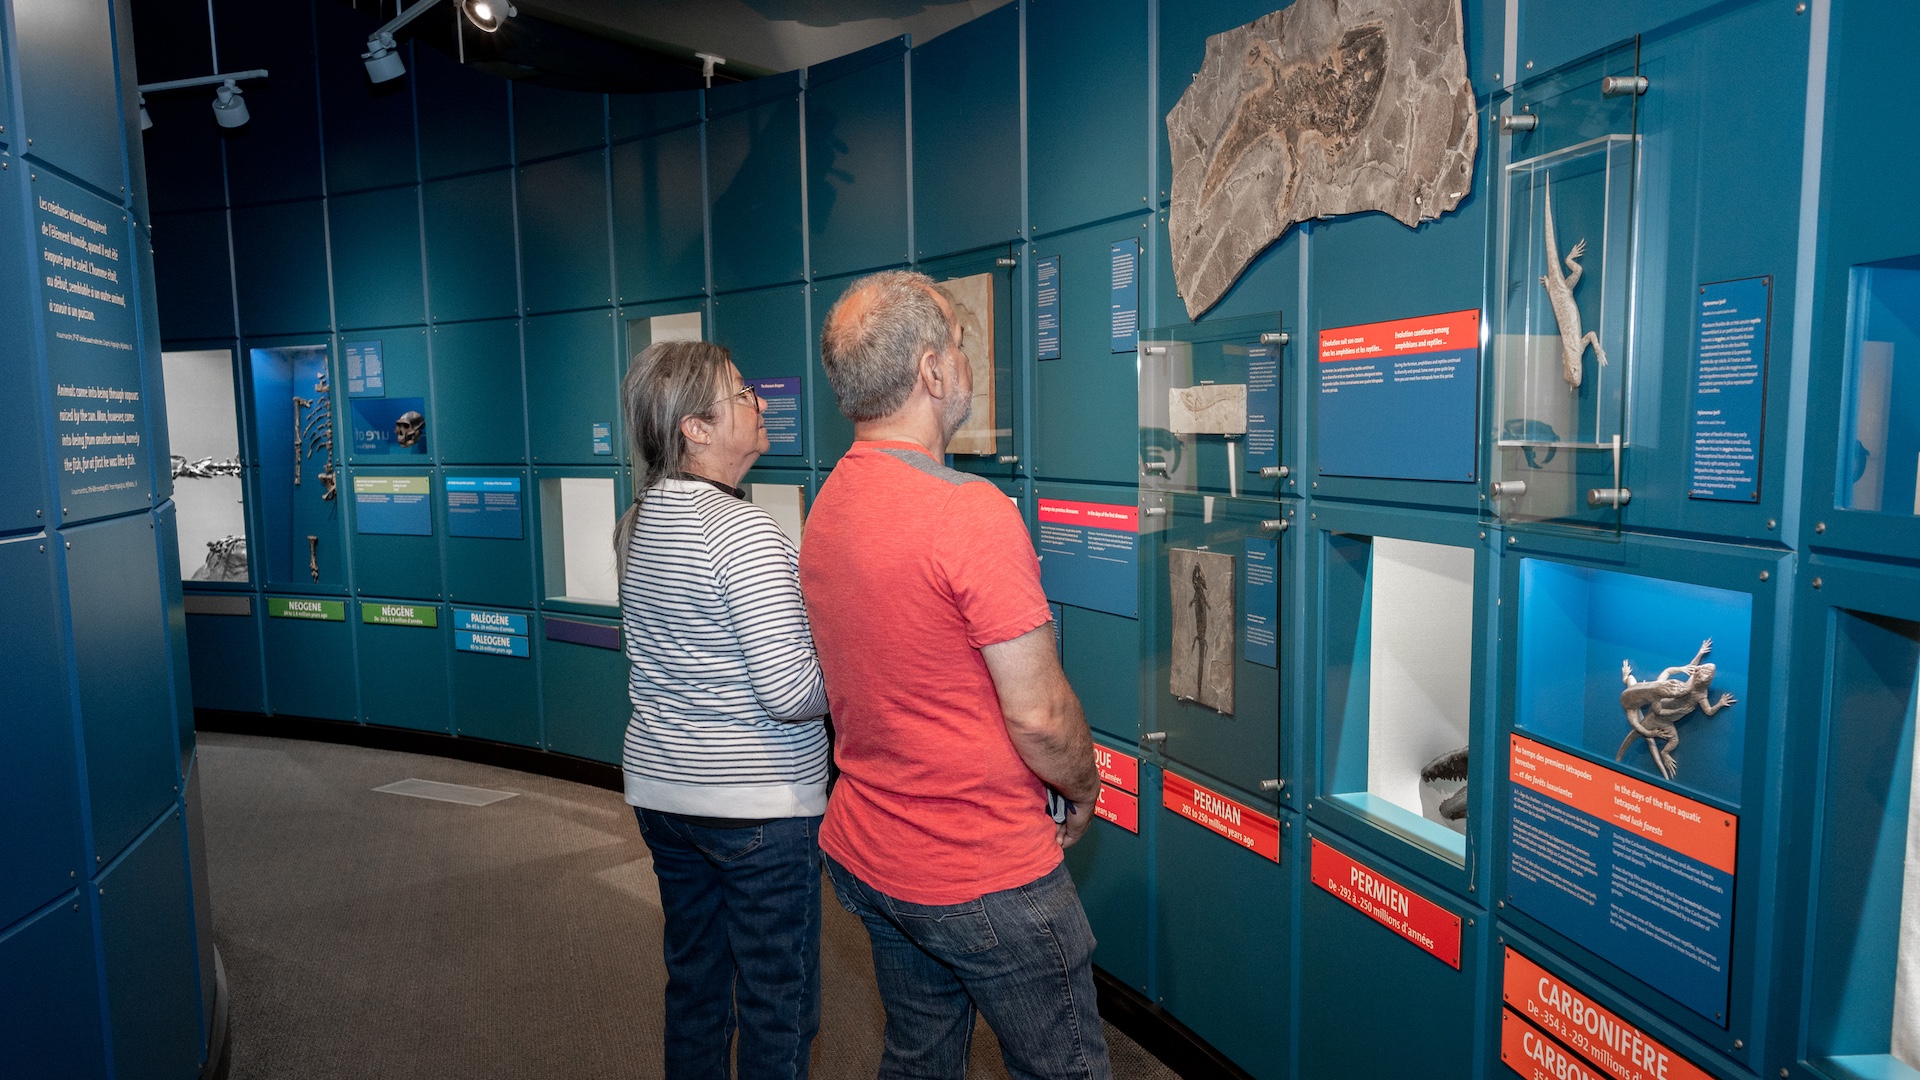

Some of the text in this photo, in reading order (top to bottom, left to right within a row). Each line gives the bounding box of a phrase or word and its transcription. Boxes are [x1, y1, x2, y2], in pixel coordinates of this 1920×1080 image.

[39, 196, 107, 235] Les créatures vivantes naquirent
[42, 222, 48, 236] de
[88, 243, 101, 255] quand
[44, 248, 63, 266] évaporé
[72, 256, 76, 269] le
[47, 277, 53, 287] au
[69, 281, 90, 297] semblable
[100, 290, 111, 302] autre
[112, 293, 126, 307] animal,
[53, 302, 67, 314] savoir
[1395, 327, 1449, 338] Evolution continues among
[1322, 339, 1341, 347] L'évolution
[1336, 348, 1355, 356] amphibiens
[1395, 338, 1442, 350] amphibians and reptiles
[57, 384, 76, 397] Animals
[76, 388, 88, 397] came
[88, 386, 97, 398] into
[97, 386, 109, 402] being
[109, 387, 124, 403] through
[60, 408, 73, 421] raised
[74, 408, 80, 425] by
[80, 409, 88, 421] the
[88, 412, 97, 421] sun.
[107, 410, 125, 423] however,
[62, 432, 139, 449] into being from another animal, namely
[64, 458, 72, 471] the
[73, 457, 82, 474] fish,
[89, 457, 94, 468] at
[94, 456, 104, 472] first
[103, 455, 109, 467] he
[109, 458, 118, 466] was
[289, 602, 321, 611] NEOGENE
[382, 605, 414, 617] NÉOGÈNE
[471, 612, 508, 625] PALÉOGÈNE
[473, 634, 510, 646] PALEOGENE
[1515, 745, 1592, 780] Au temps des premiers tétrapodes
[1515, 757, 1536, 770] terrestres
[1101, 769, 1122, 784] d'années
[1532, 776, 1546, 787] forêts
[1546, 781, 1572, 798] luxuriantes
[1194, 789, 1240, 826] PERMIAN
[1614, 796, 1641, 813] tetrapods
[1615, 783, 1700, 823] In the days of the first aquatic
[1108, 810, 1118, 822] ago
[1182, 804, 1254, 847] 292 to 250 million years ago
[1619, 814, 1662, 836] and lush forests
[1351, 867, 1408, 917] PERMIEN
[1329, 878, 1434, 949] De -292 à -250 millions d'années
[1538, 977, 1668, 1080] CARBONIFÈRE
[1528, 999, 1539, 1016] De
[1540, 1010, 1560, 1032] -354
[1561, 1022, 1567, 1037] à
[1568, 1030, 1589, 1052] -292
[1591, 1045, 1630, 1080] millions
